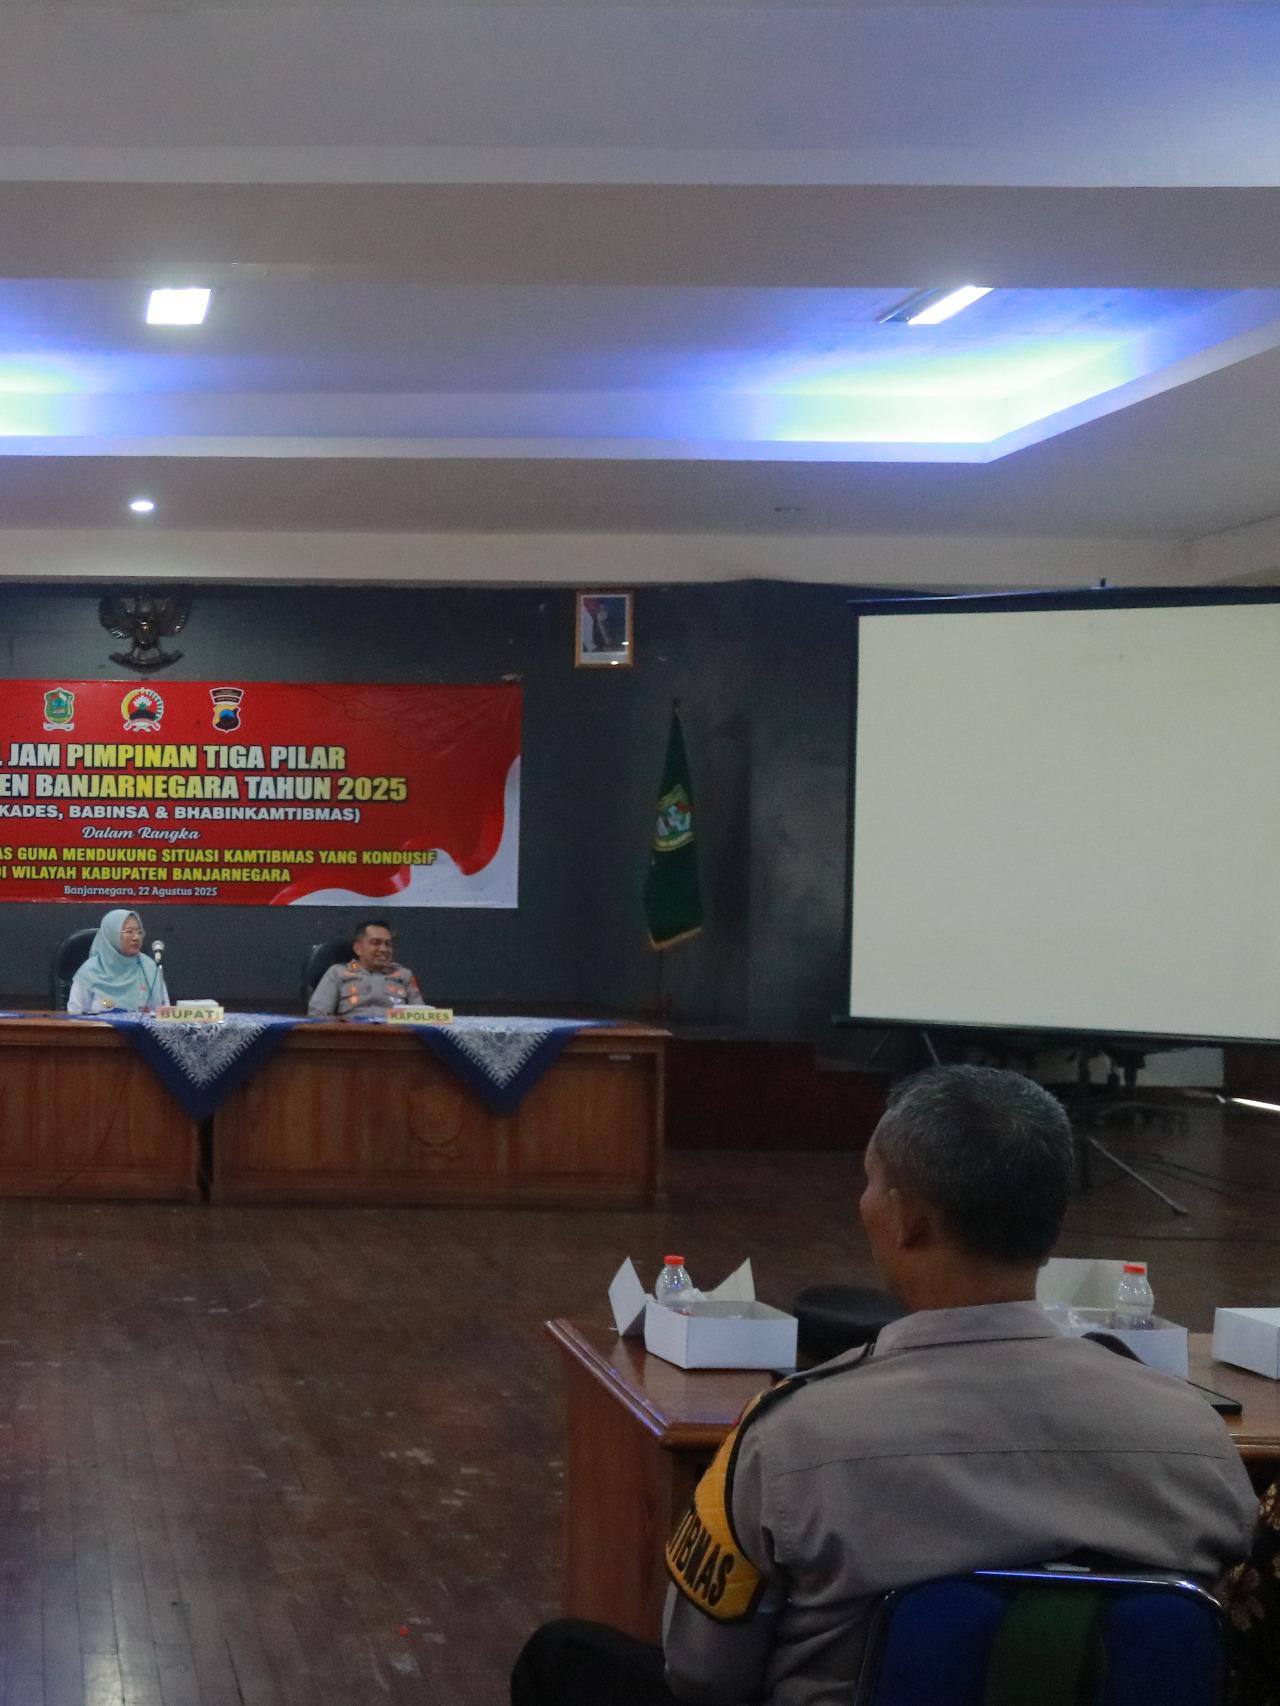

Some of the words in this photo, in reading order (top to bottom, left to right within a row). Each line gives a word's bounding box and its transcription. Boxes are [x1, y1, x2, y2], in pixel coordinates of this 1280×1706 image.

[8, 743, 61, 767] JAM
[66, 744, 197, 768] PIMPINAN
[203, 745, 265, 769] TIGA
[270, 746, 346, 769] PILAR
[35, 774, 240, 799] BANJARNEGARA
[245, 776, 331, 800] TAHUN
[337, 776, 408, 800] 2025
[69, 805, 150, 819] BABINSA
[154, 805, 169, 819] &
[174, 807, 361, 823] BHABINKAMTIBMAS)
[82, 826, 134, 839] Dalam
[138, 827, 200, 843] Rangka
[17, 847, 58, 862] GUNA
[62, 848, 157, 862] MENDUKUNG
[161, 848, 219, 863] SITUASI
[224, 849, 314, 864] KAMTIBMAS
[319, 850, 358, 864] YANG
[362, 851, 438, 865] KONDUSIF
[12, 866, 75, 880] WILAYAH
[81, 867, 167, 881] KABUPATEN
[172, 868, 291, 882] BANJARNEGARA
[64, 885, 137, 897] Banjarnegara,
[138, 886, 149, 896] 22
[152, 886, 193, 898] Agustus
[194, 887, 218, 897] 2025
[391, 1011, 449, 1021] KAPOLRES
